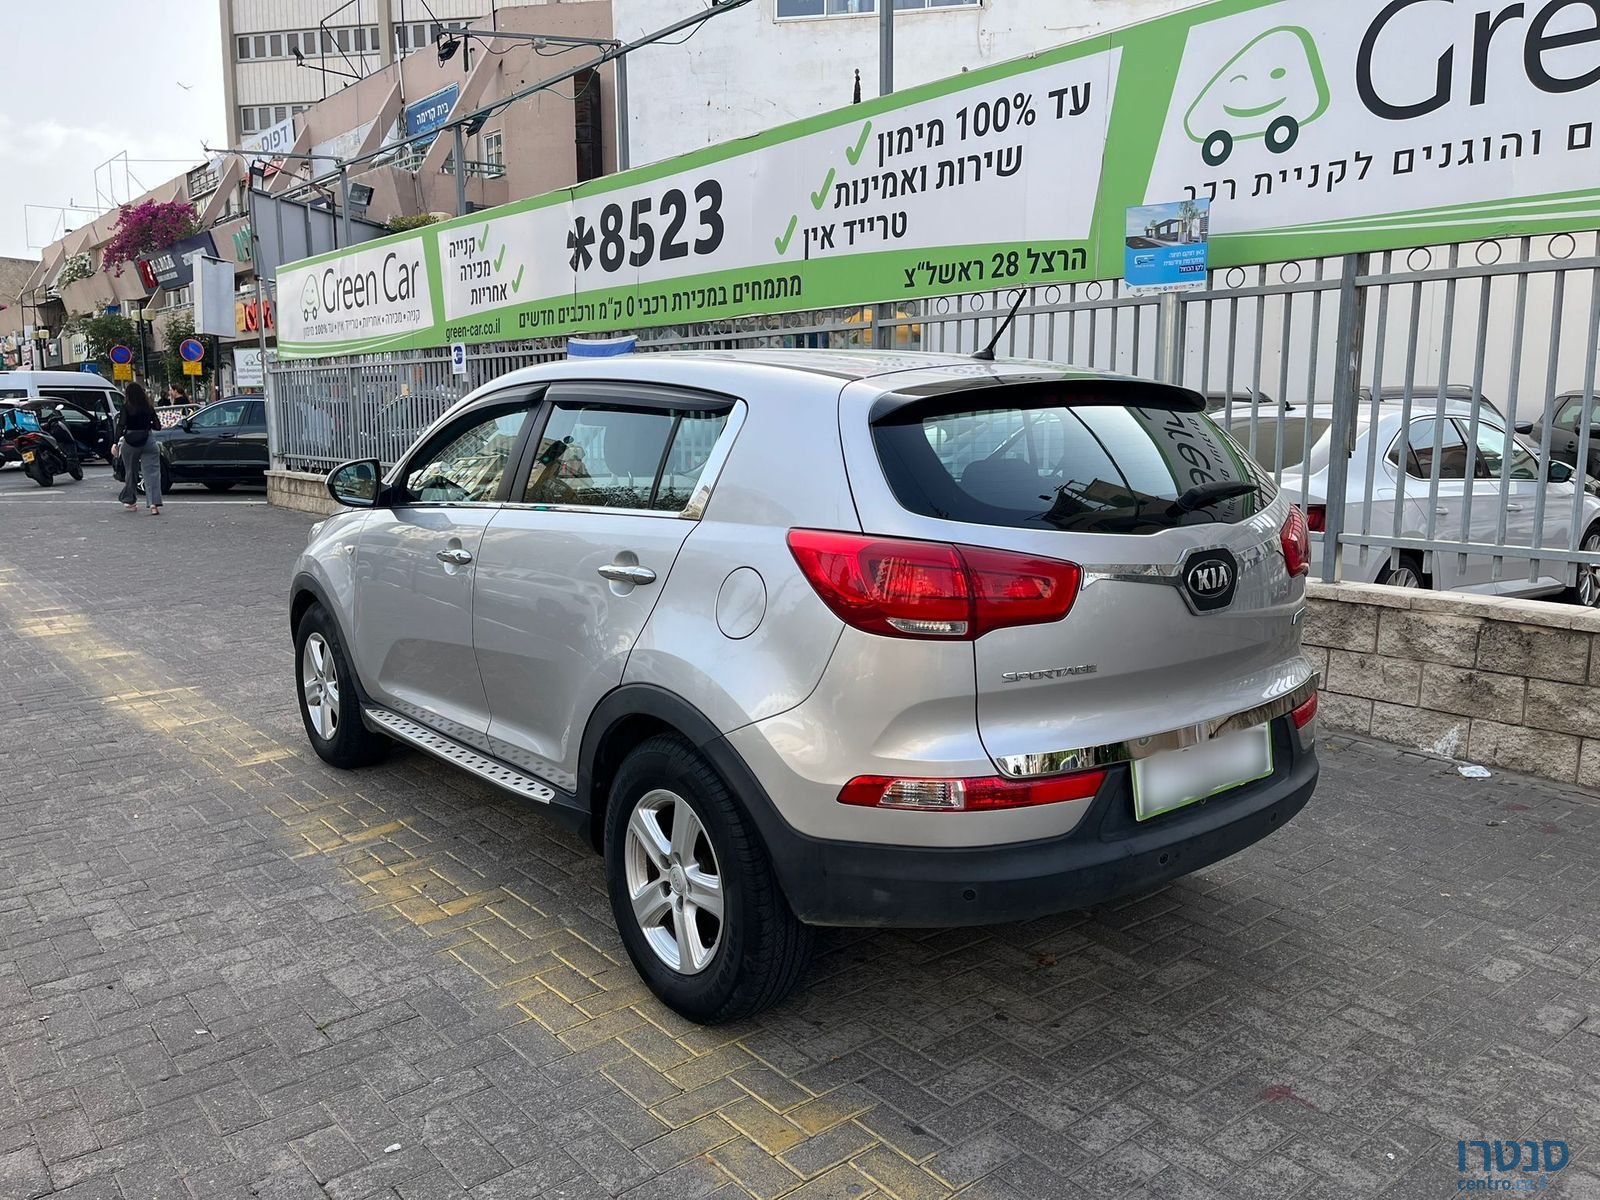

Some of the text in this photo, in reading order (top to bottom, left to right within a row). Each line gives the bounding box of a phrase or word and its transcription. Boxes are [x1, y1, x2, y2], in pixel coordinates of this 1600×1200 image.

[437, 102, 449, 116] בית
[878, 81, 1092, 167] עד 100% מימון
[261, 126, 288, 152] דפוס
[1393, 128, 1541, 175] והוגנים
[833, 145, 1023, 210] שירות ואמינות
[1252, 150, 1372, 197] לקניית
[449, 236, 476, 258] קנייה
[803, 211, 908, 260] טרייד אין
[460, 260, 491, 282] מכירה
[991, 253, 1019, 279] 28
[1027, 246, 1087, 273] הרצל
[322, 252, 420, 313] Green Car
[471, 282, 508, 306] אחריות
[732, 274, 802, 304] מתמחים
[638, 298, 667, 317] רכבי
[672, 286, 727, 311] במכירת
[519, 310, 554, 329] חדשים
[558, 304, 594, 324] ורכבים
[445, 317, 501, 343] green-car.co.il
[1195, 567, 1230, 594] KIA
[1001, 664, 1097, 684] SPORTAGE
